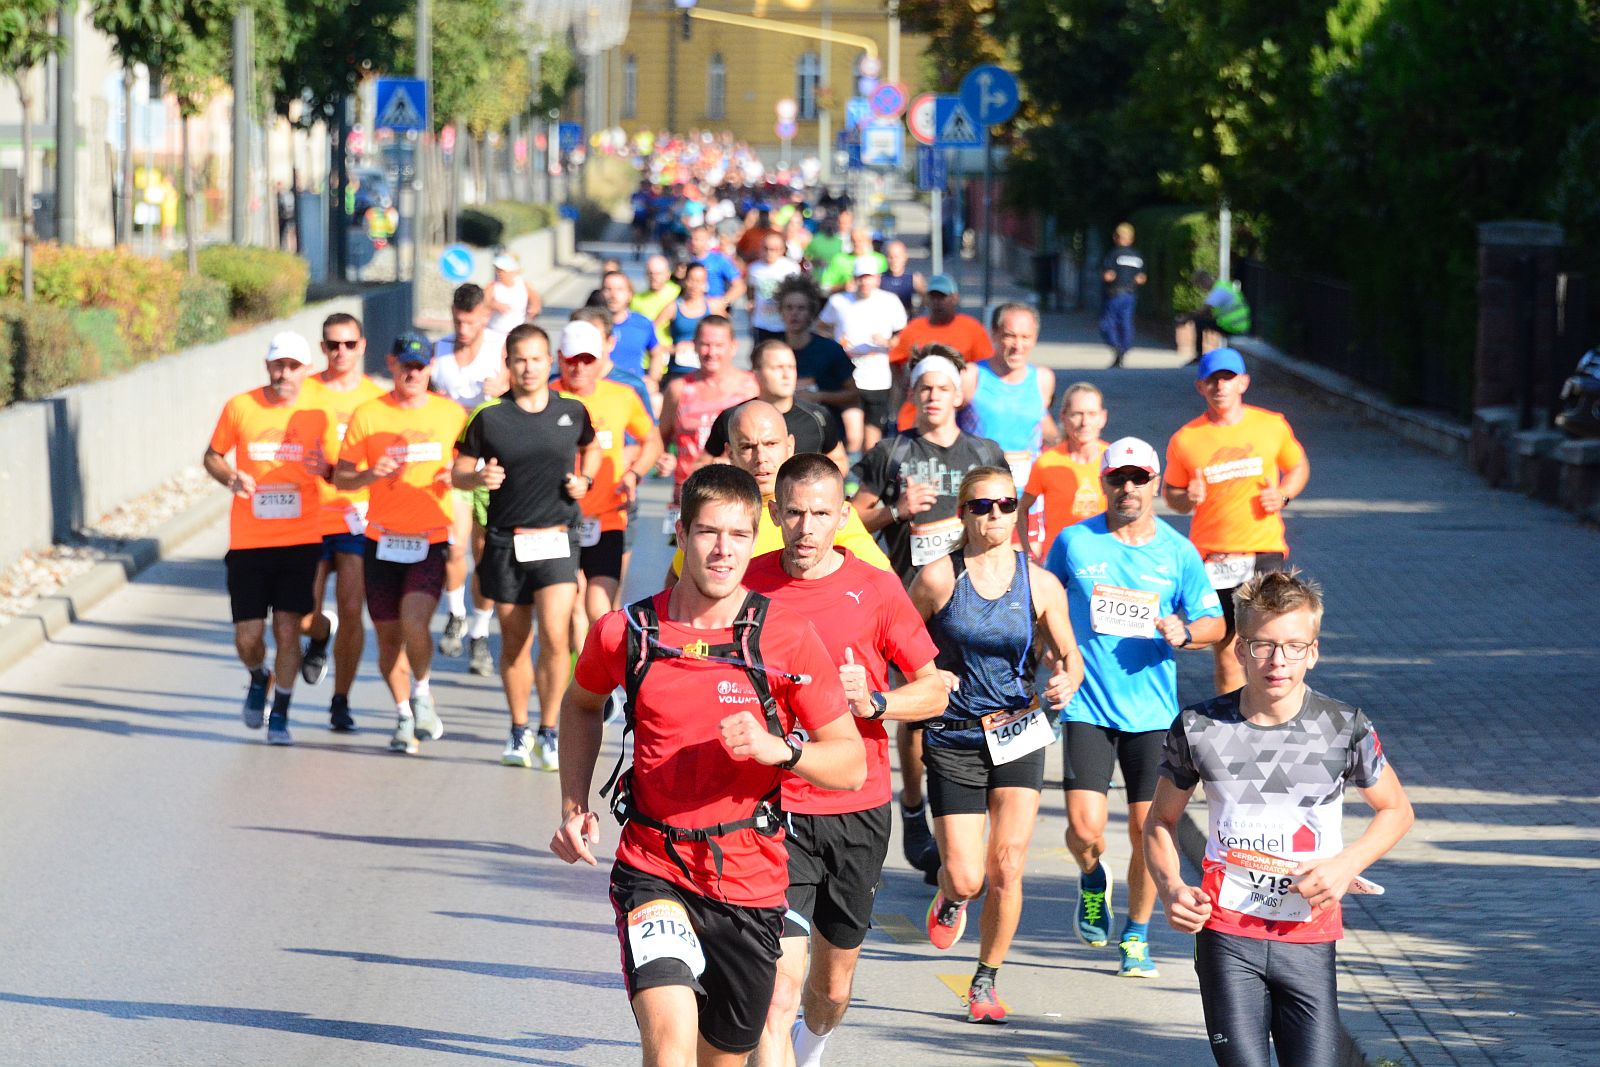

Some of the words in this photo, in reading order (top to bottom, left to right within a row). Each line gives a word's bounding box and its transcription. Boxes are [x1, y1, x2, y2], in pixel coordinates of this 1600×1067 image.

[260, 494, 296, 506] 21132
[1096, 599, 1150, 620] 21092
[991, 712, 1039, 744] 14074
[1218, 830, 1285, 852] kendel
[1231, 851, 1271, 866] CERBONA
[1250, 891, 1278, 908] TRIKIDS
[632, 903, 671, 920] CERBONA
[641, 919, 697, 948] 21129
